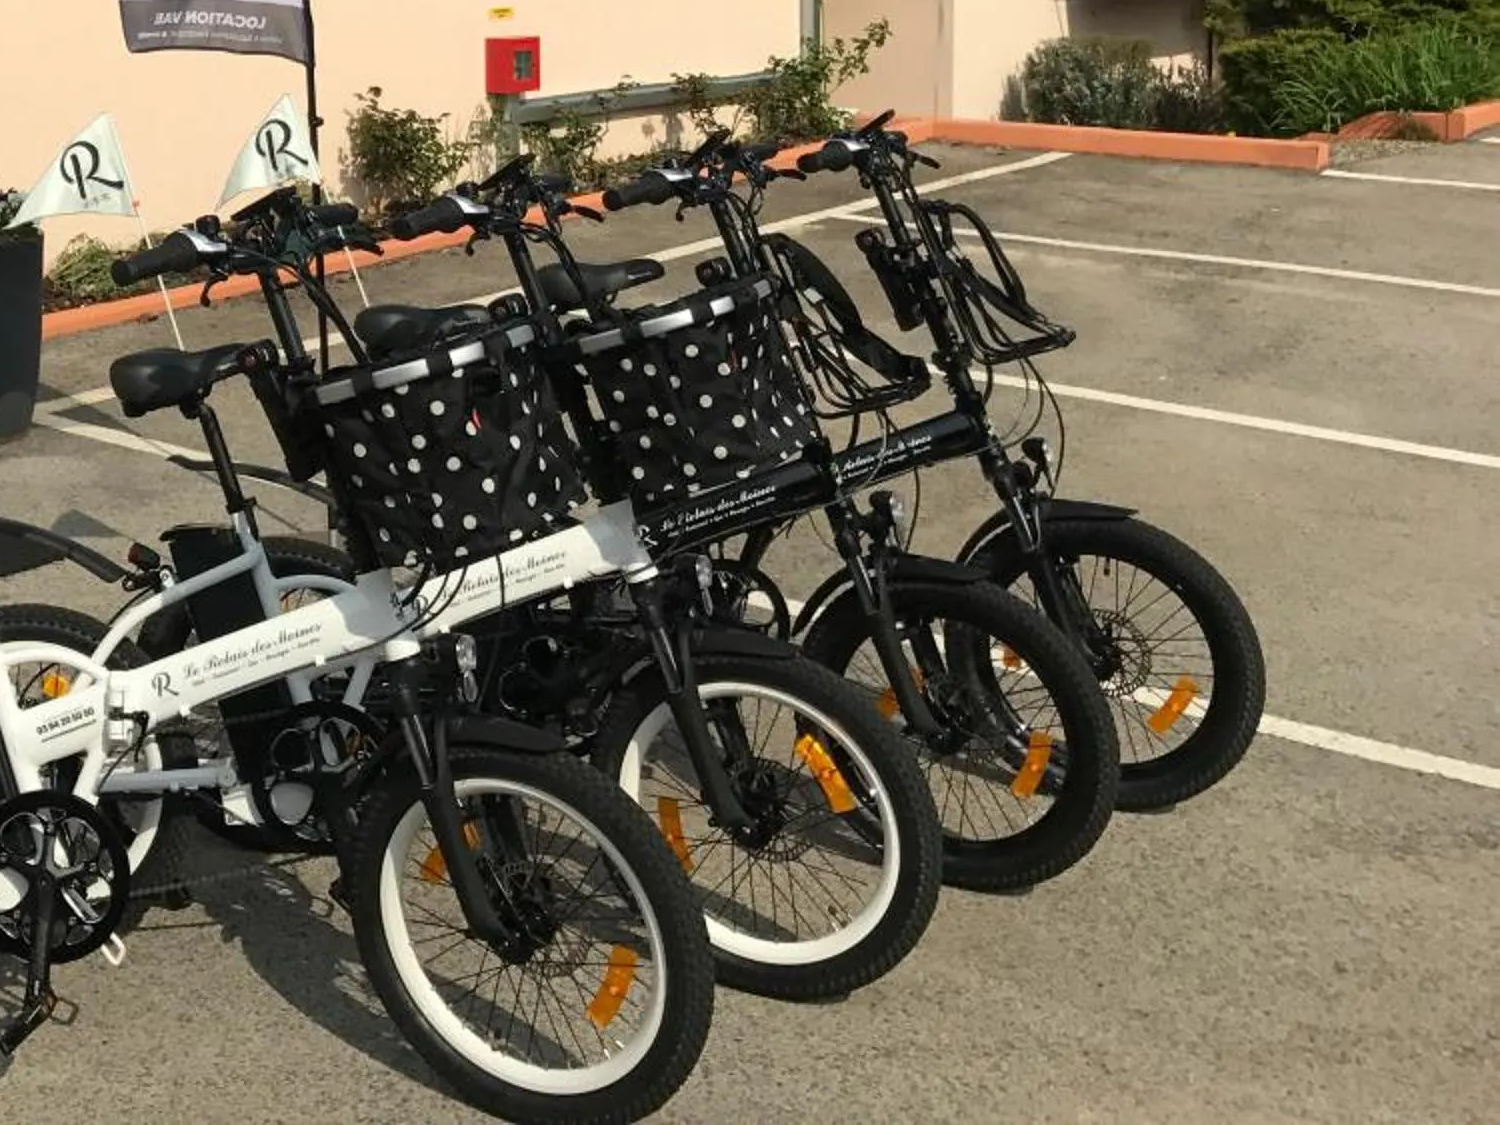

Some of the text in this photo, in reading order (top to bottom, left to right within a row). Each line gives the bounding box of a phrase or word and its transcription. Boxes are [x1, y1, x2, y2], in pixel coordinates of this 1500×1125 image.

[60, 140, 124, 200] R
[255, 118, 309, 172] R
[151, 671, 180, 697] R
